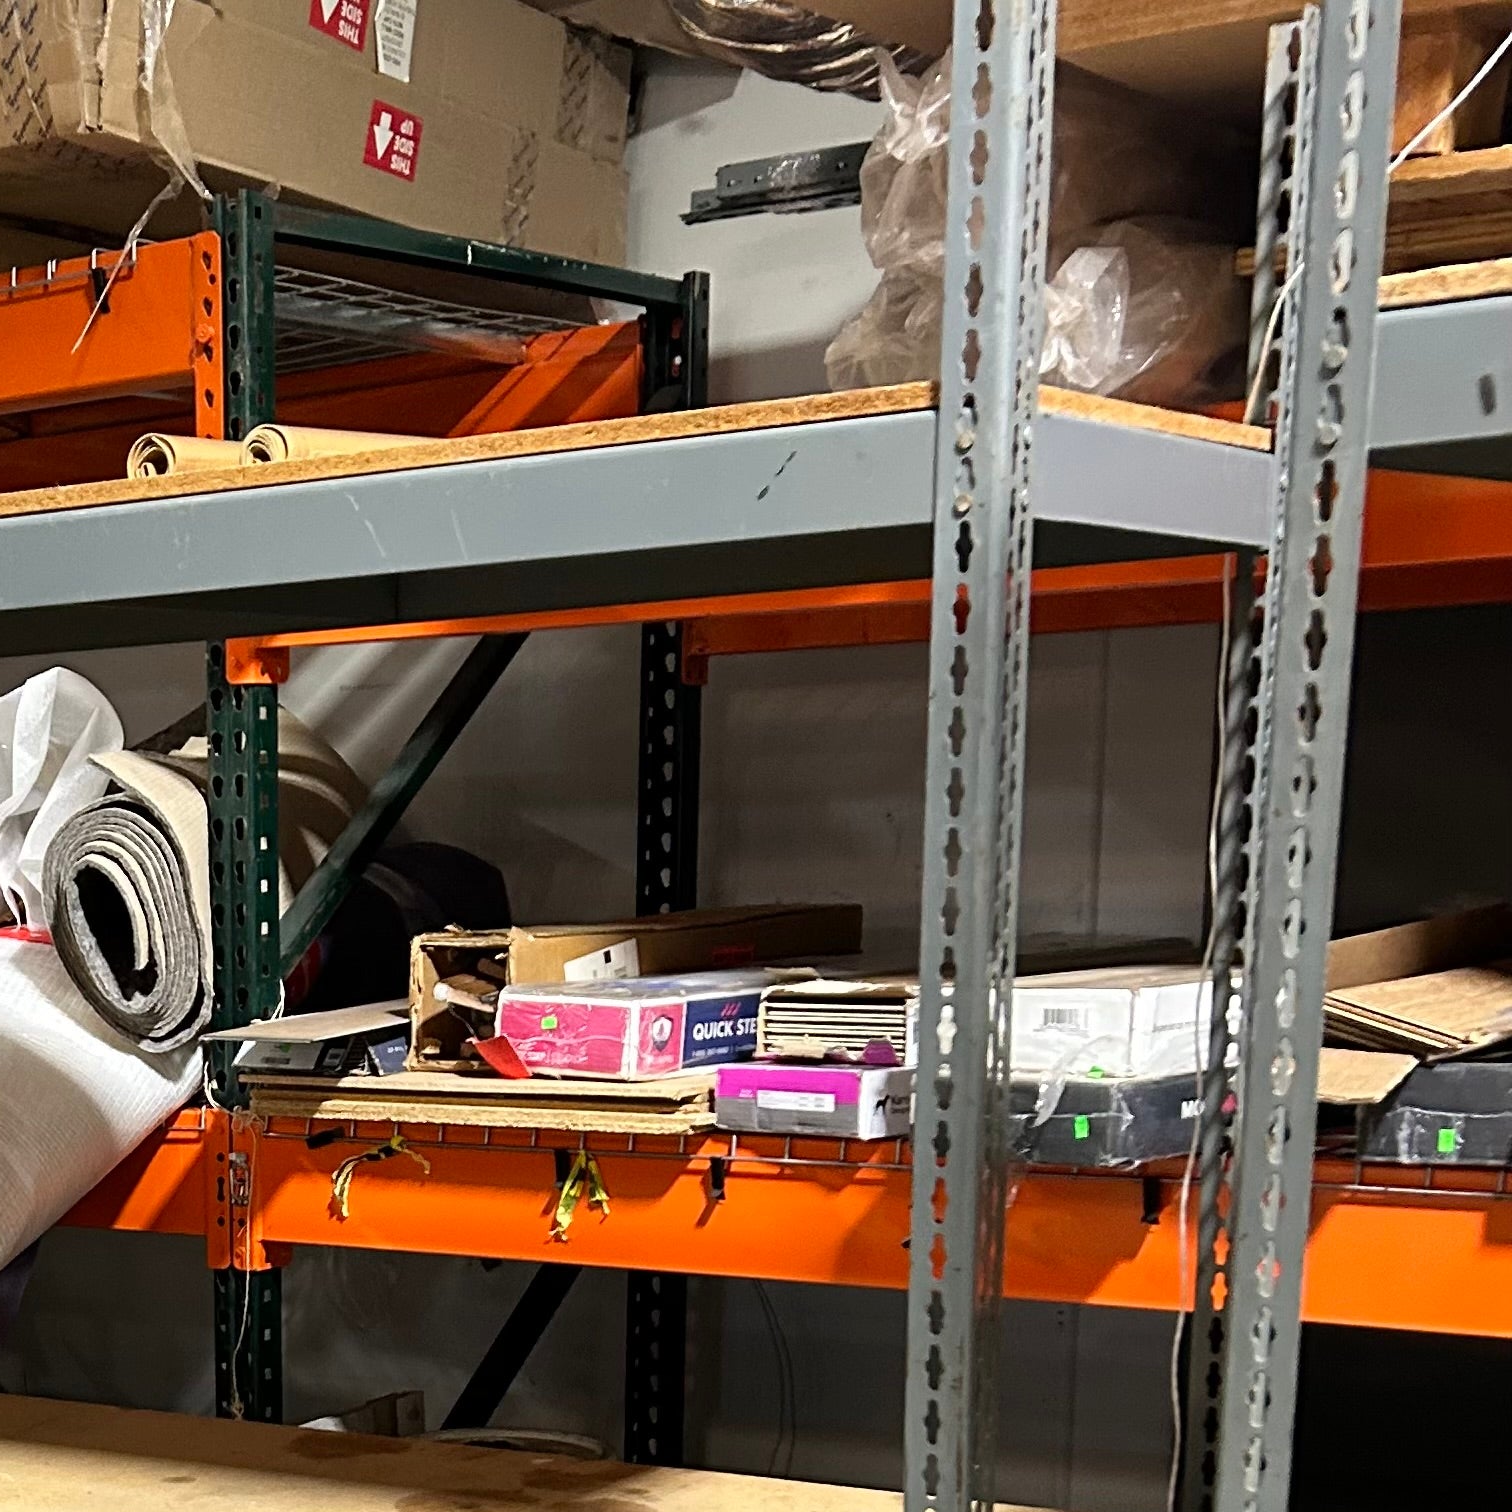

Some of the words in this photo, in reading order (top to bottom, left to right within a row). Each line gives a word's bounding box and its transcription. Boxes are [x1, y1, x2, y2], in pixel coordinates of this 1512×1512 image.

[341, 1, 364, 25] SIDE
[338, 20, 360, 45] THIS
[400, 119, 415, 137] UP
[393, 134, 415, 157] SIDE
[390, 153, 411, 175] THIS
[692, 1021, 734, 1042] QUICK
[736, 1017, 757, 1036] STE
